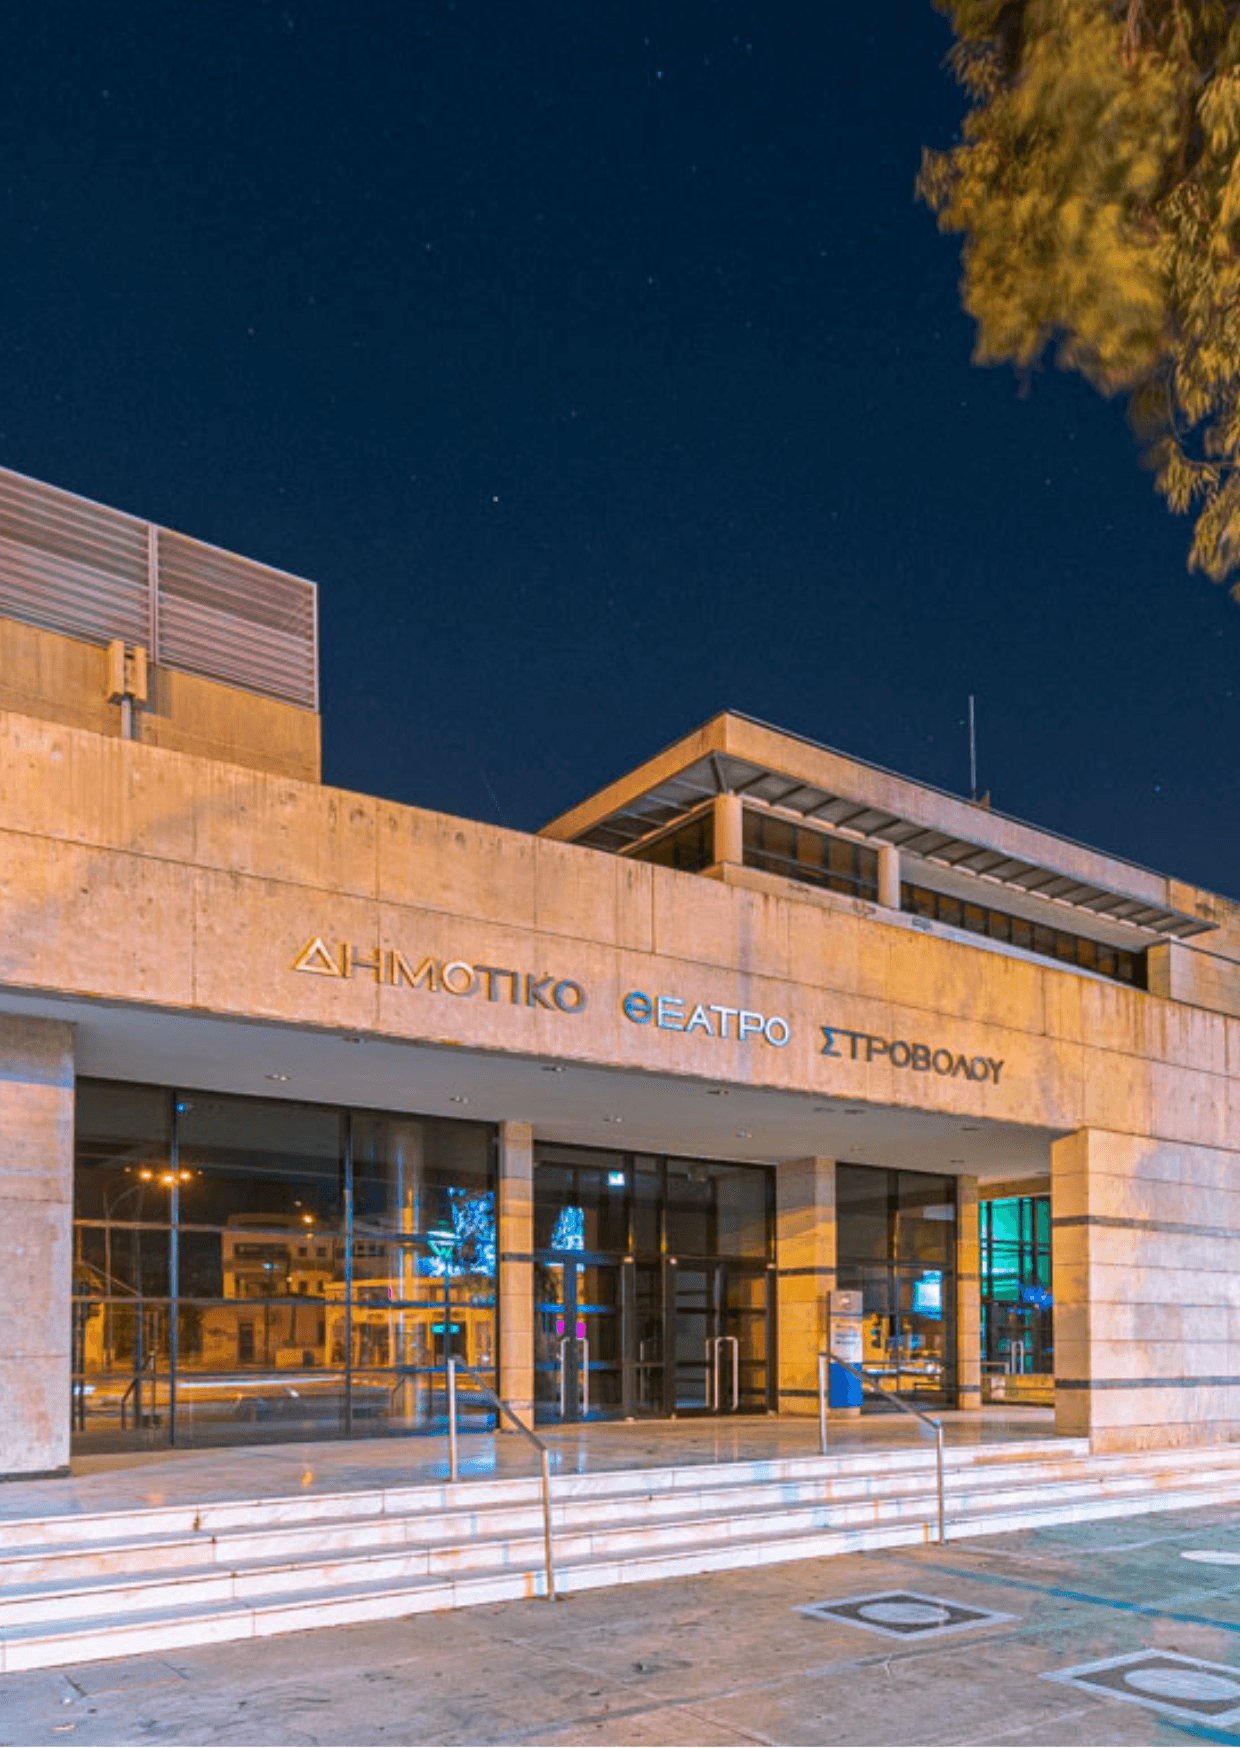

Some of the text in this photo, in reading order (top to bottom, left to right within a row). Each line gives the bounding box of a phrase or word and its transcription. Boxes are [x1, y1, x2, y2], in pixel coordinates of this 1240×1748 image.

[292, 937, 1005, 1085] ΔΗΜΟΤΙΚΟ ΘΕΑΤΡΟ ΣΤΡΟΒΟΛΟΥ
